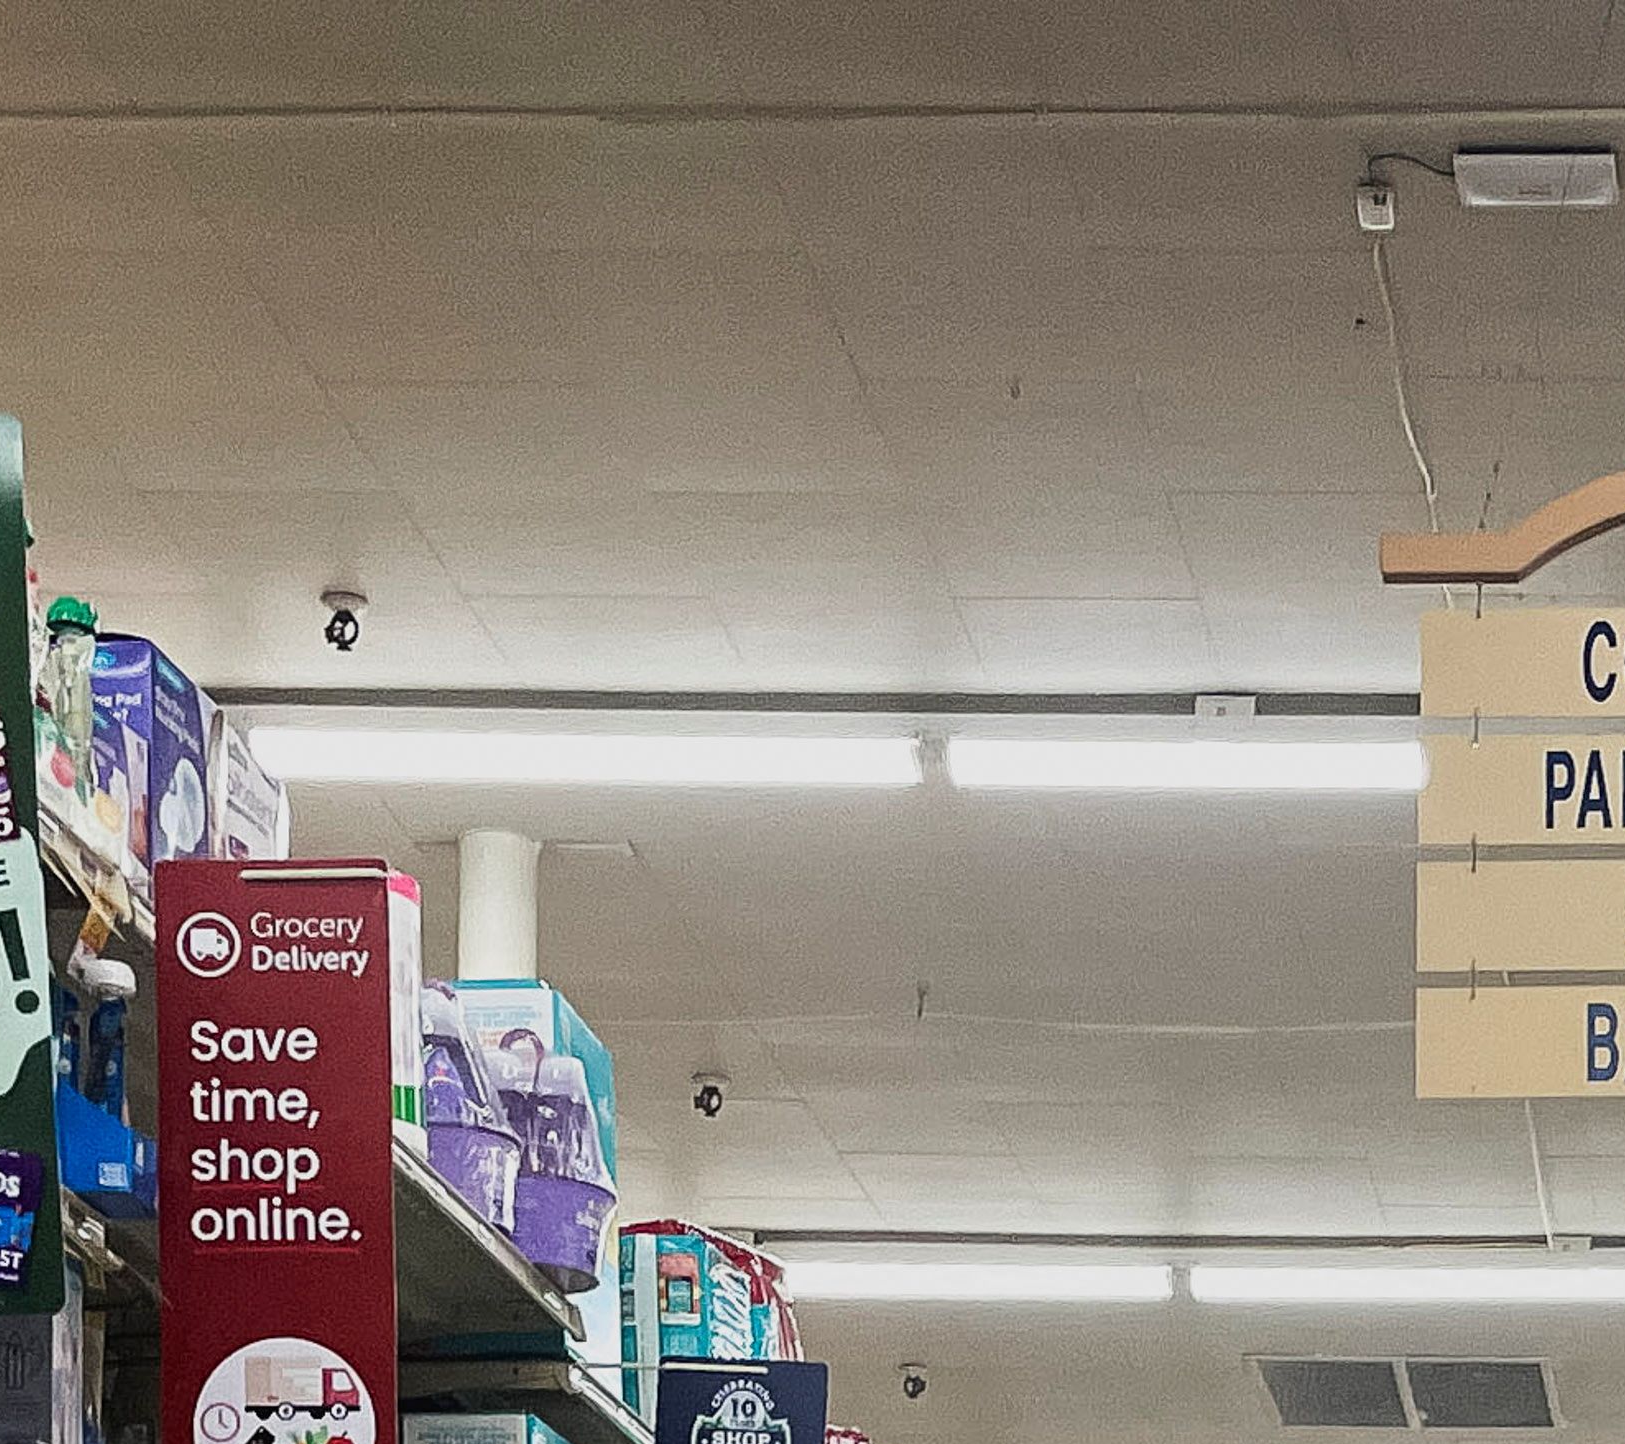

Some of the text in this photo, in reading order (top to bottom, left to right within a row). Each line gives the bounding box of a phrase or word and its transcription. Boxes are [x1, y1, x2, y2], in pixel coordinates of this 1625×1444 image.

[250, 912, 364, 940] Grocery
[251, 945, 370, 977] Delivery
[190, 1021, 318, 1062] Save
[190, 1076, 320, 1128] time,
[190, 1139, 320, 1193] shop
[191, 1197, 363, 1241] online.
